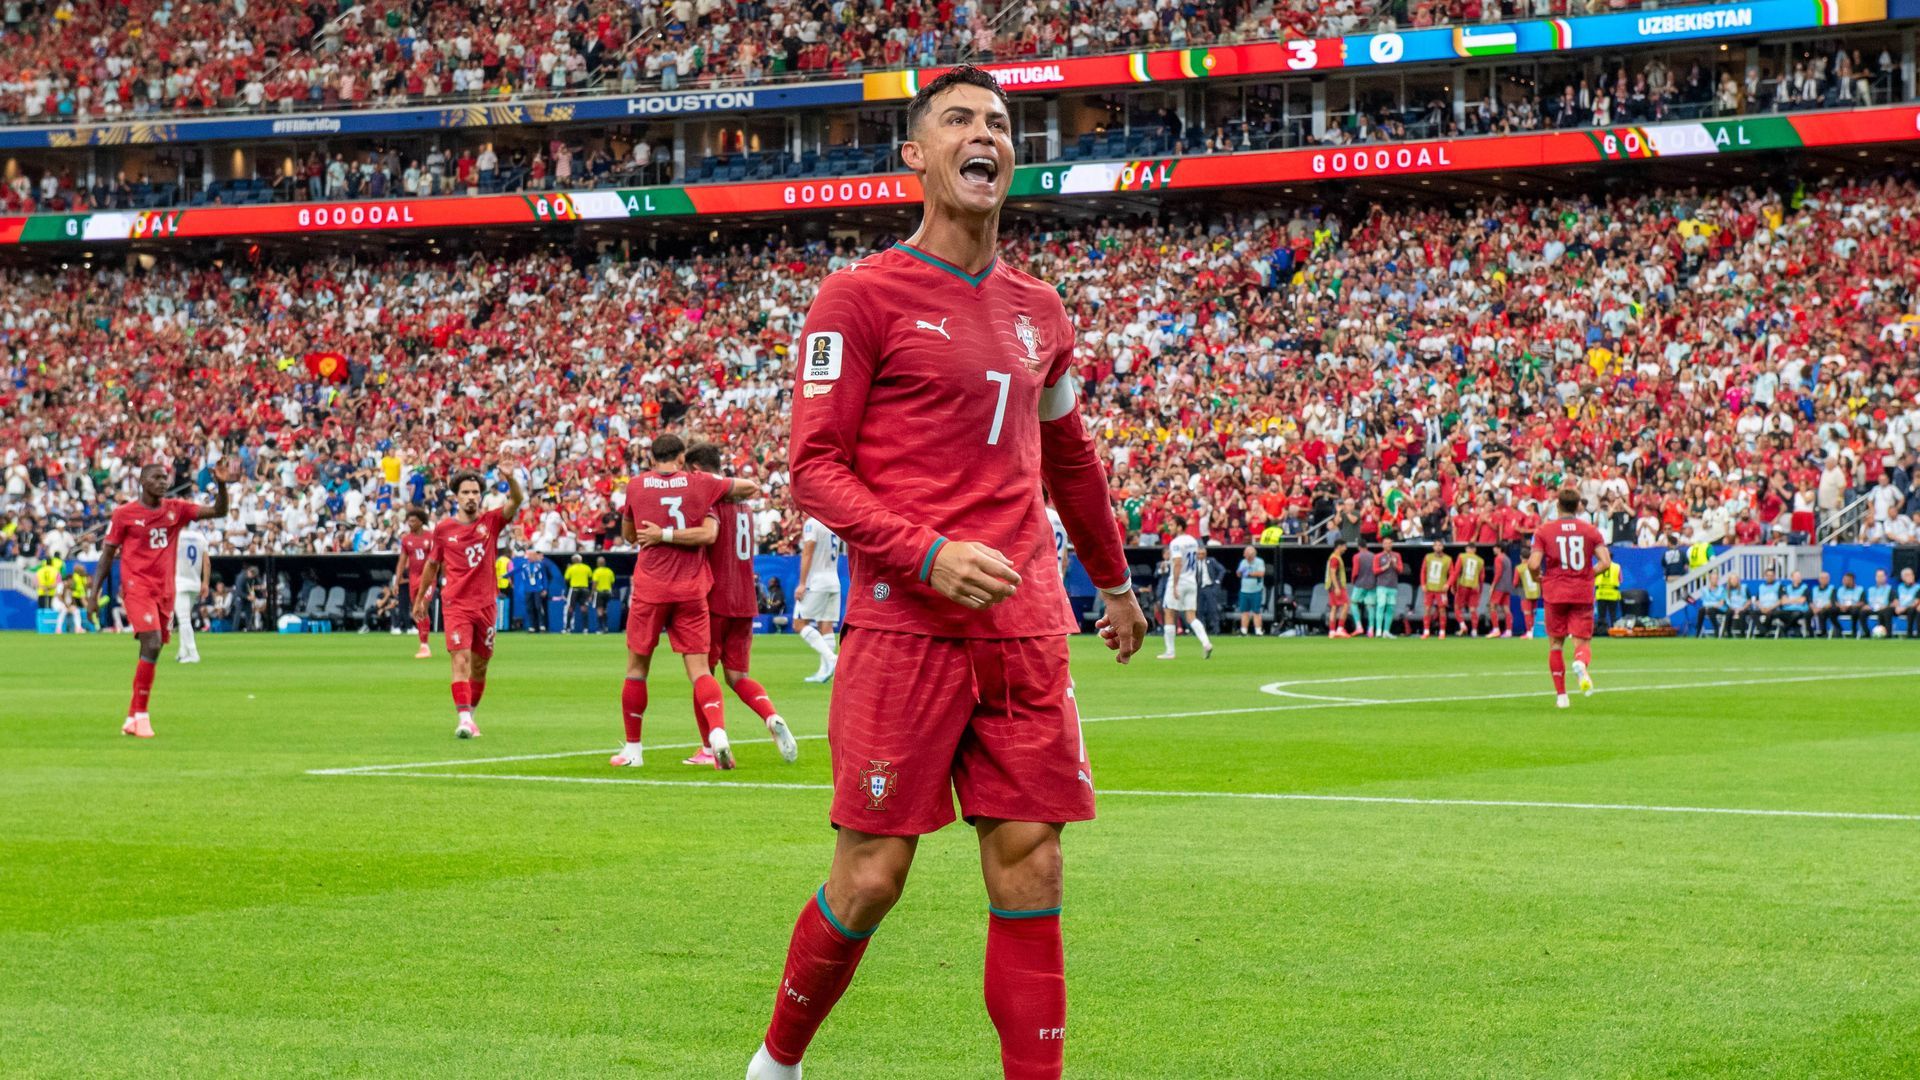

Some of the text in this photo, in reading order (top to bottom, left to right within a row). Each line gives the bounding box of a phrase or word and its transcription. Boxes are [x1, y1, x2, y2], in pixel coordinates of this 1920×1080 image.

[986, 8, 1752, 85] ORTUGAL 3 0 UZBEKISTAN
[628, 92, 754, 114] HOUSTON
[273, 117, 341, 133] #FIFAWorldCup
[1312, 147, 1450, 173] GOOOOAL
[1041, 165, 1171, 189] GOAL
[784, 181, 906, 204] GOOOOAL
[298, 206, 414, 226] GOOOOAL
[537, 194, 656, 216] GOAL
[65, 214, 179, 236] GOAL
[986, 371, 1011, 445] 7
[660, 496, 686, 530] 3
[149, 527, 168, 550] 25
[736, 512, 751, 561] 8
[187, 545, 197, 567] 9
[465, 542, 486, 568] 23
[1556, 536, 1585, 571] 18
